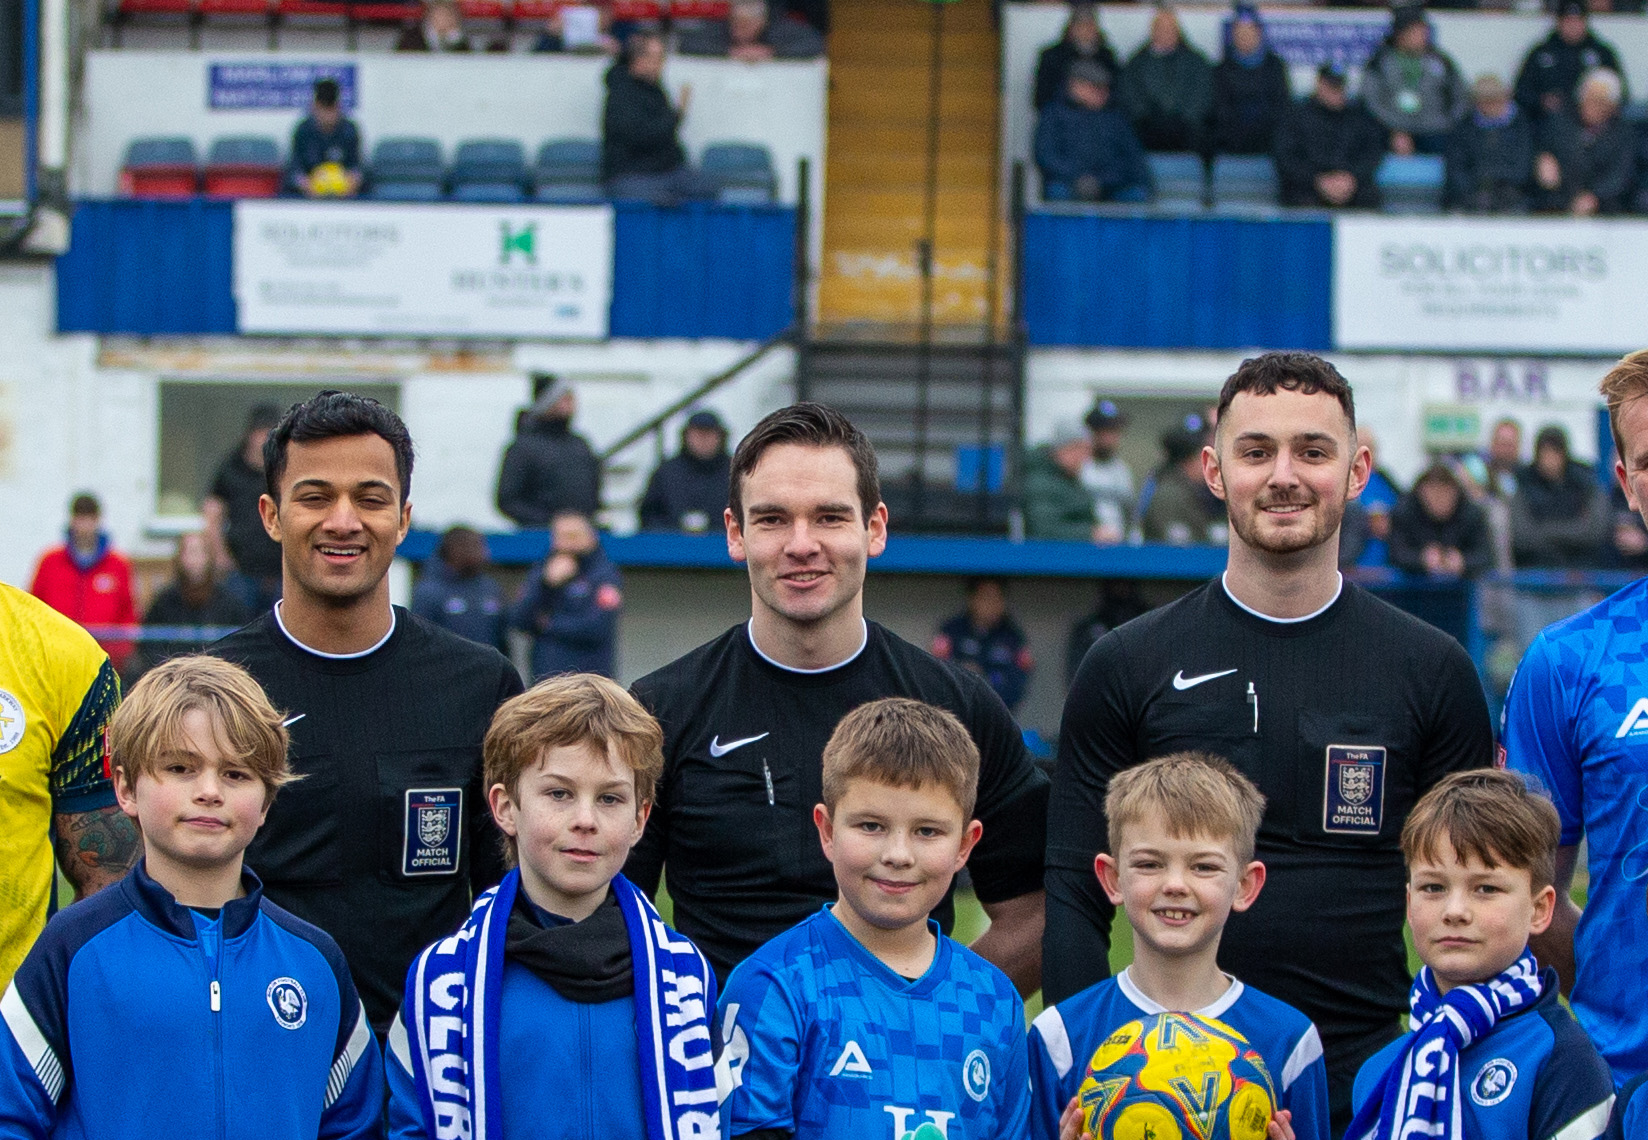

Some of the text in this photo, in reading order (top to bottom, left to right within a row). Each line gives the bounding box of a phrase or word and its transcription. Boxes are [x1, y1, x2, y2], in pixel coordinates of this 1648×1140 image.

[1380, 244, 1608, 278] SOLICITORS
[1455, 361, 1549, 400] BAR
[1337, 805, 1372, 815] MATCH
[1332, 815, 1376, 826] OFFICIAL
[417, 847, 449, 857] MATCH
[411, 858, 452, 867] OFFICIAL
